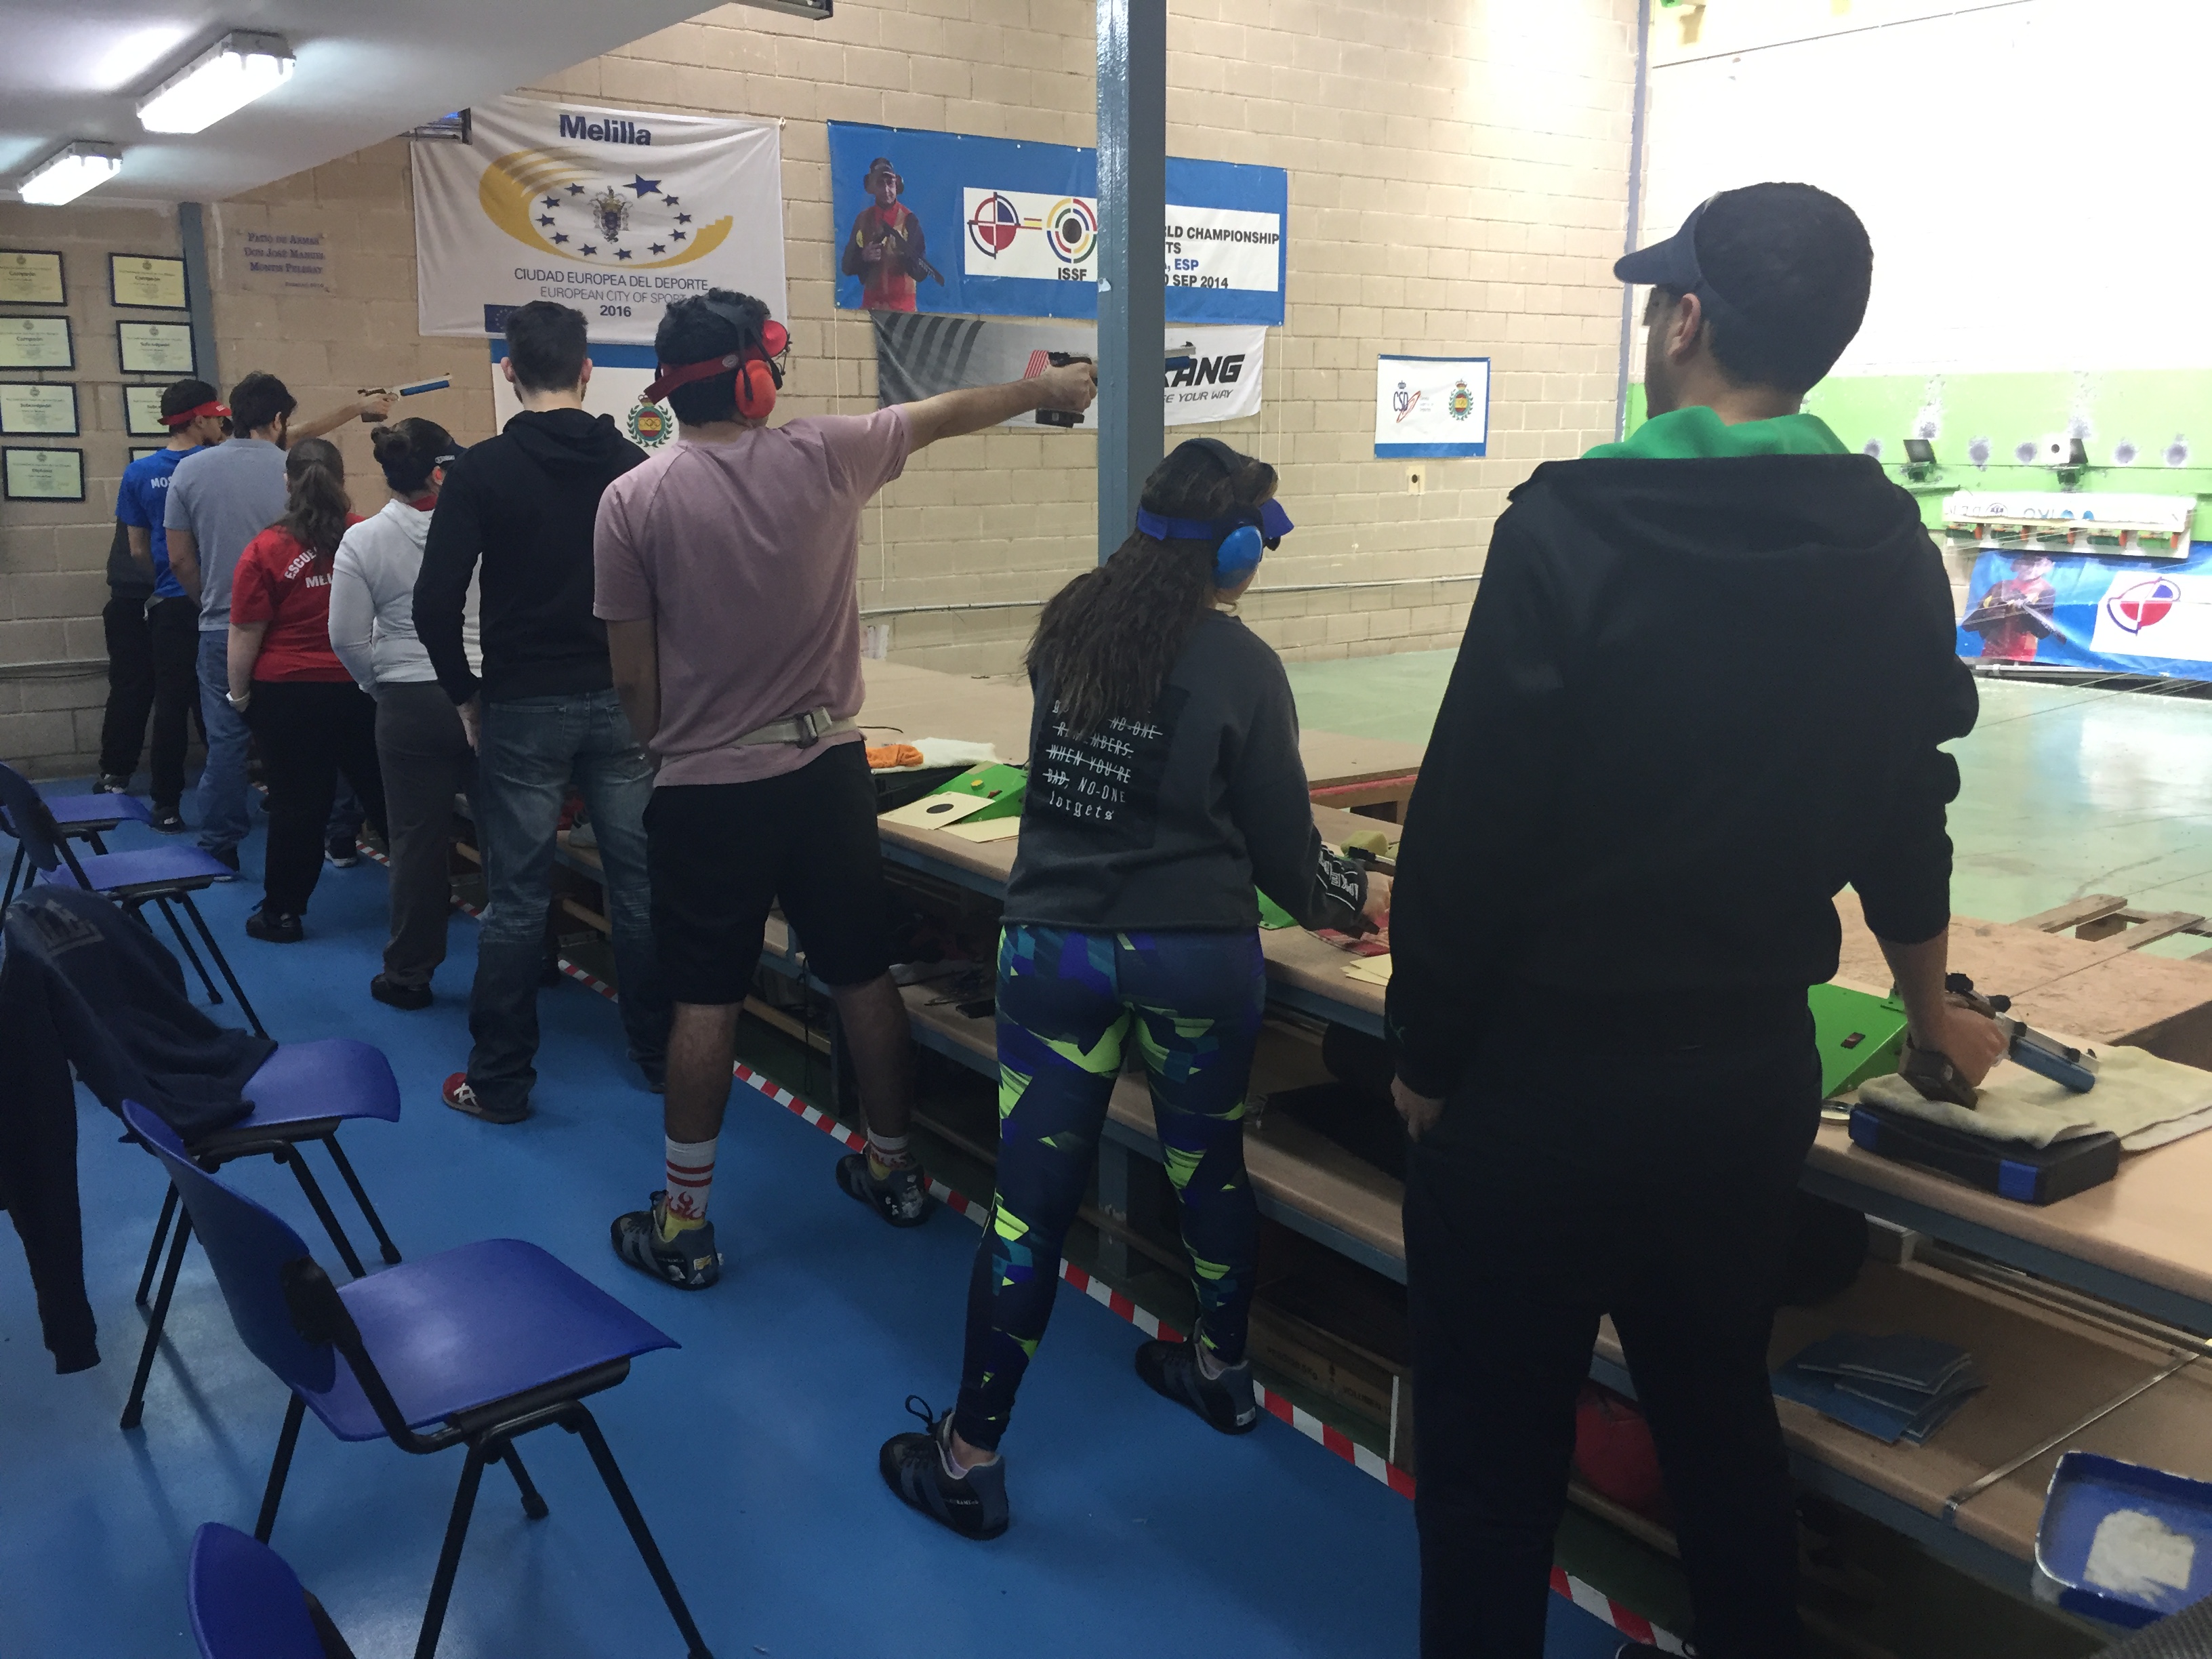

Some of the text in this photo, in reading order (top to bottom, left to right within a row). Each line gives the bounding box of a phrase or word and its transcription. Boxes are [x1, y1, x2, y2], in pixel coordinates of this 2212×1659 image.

[560, 114, 651, 145] Melilla
[1187, 226, 1279, 245] CHAMPIONSHIP
[1174, 258, 1199, 270] ESP
[514, 268, 708, 291] CIUDAD EUROPEA DEL DEPORTE
[1058, 267, 1088, 281] ISSF
[1172, 274, 1197, 287] SEP
[1200, 276, 1229, 289] 2014
[540, 286, 604, 300] EUROPEAN
[606, 289, 630, 302] CITY
[633, 291, 647, 303] OF
[600, 305, 632, 317] 2016
[1179, 391, 1208, 403] YOUR
[1211, 390, 1233, 399] WAY
[1108, 716, 1163, 739] NO-ONE
[1046, 743, 1131, 783] WHEN YOU'RE
[1078, 777, 1126, 803] NO-ONE
